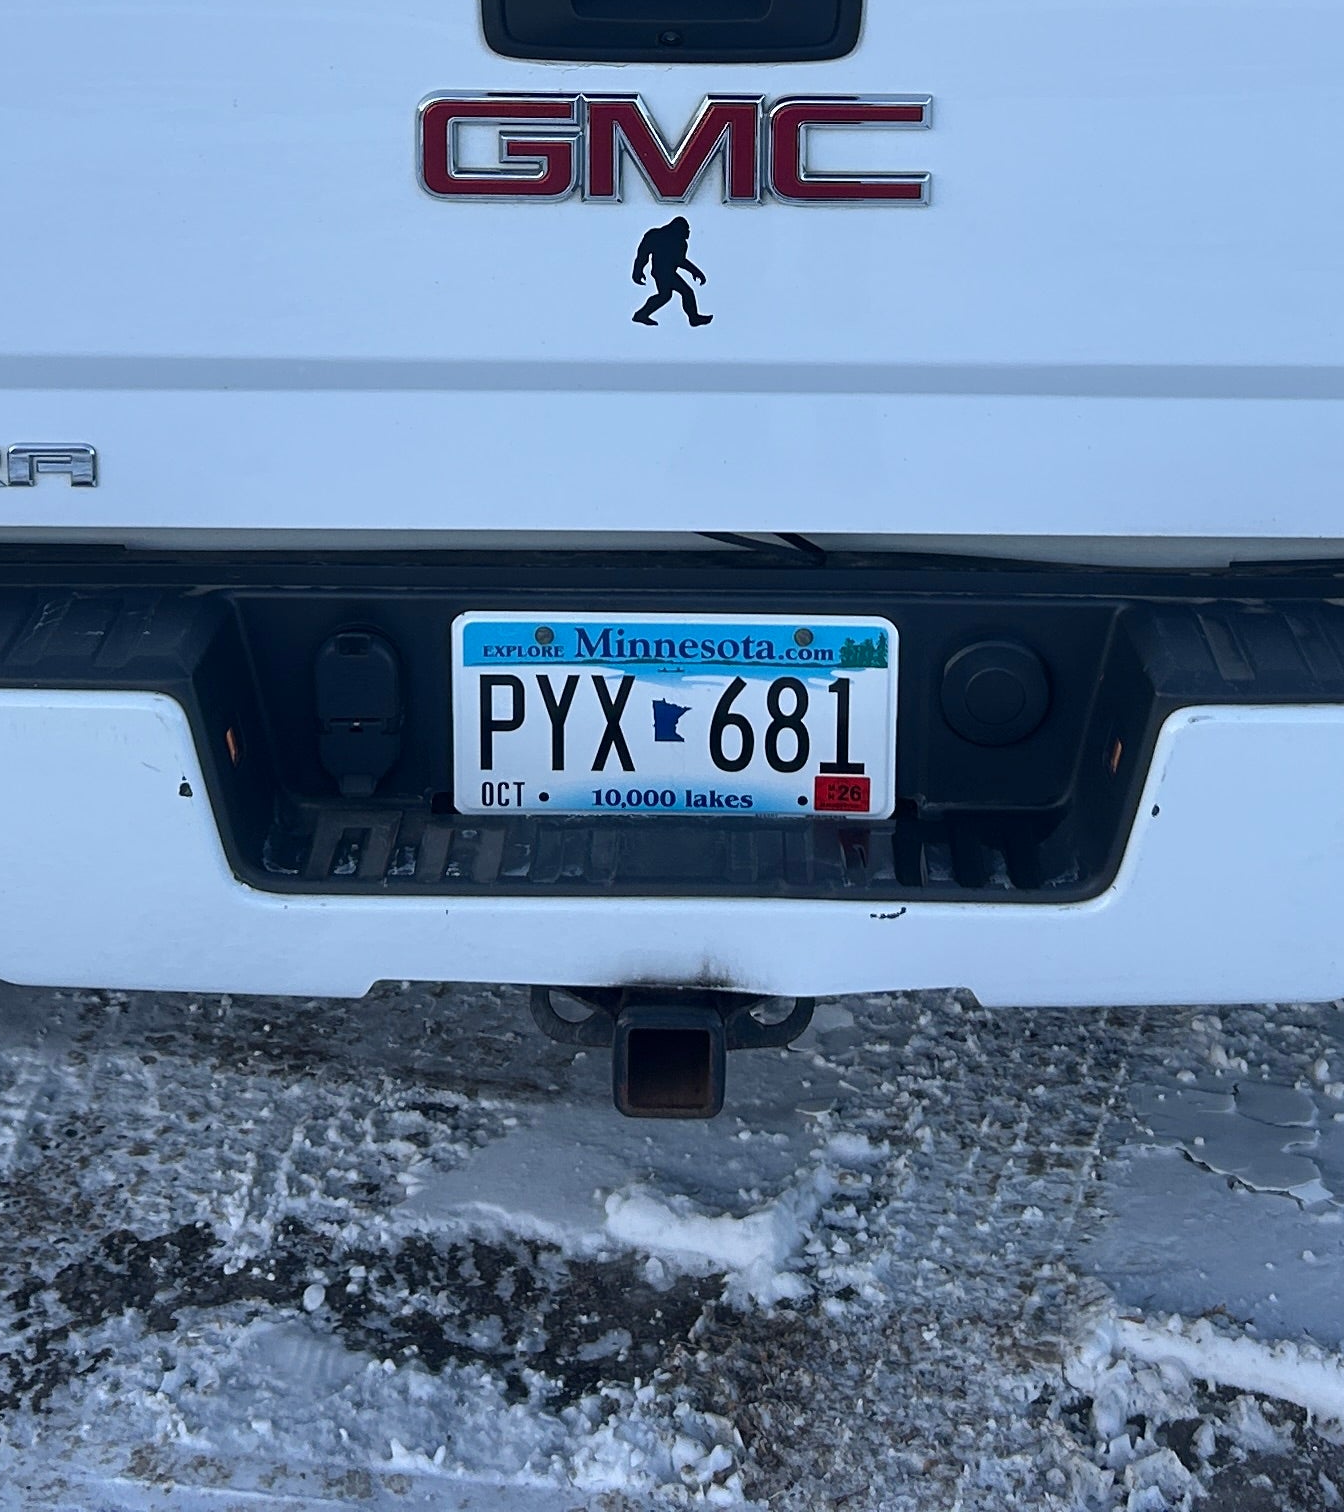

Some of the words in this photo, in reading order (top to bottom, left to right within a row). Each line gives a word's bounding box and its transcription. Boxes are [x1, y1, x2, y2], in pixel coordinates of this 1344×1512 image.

[416, 89, 934, 207] GMC
[483, 644, 565, 658] EXPLORE
[574, 627, 834, 662] Minnesota.com
[479, 674, 636, 772] PYX
[708, 675, 866, 775] 681
[480, 781, 526, 808] OCT
[591, 788, 677, 809] 10,000
[685, 789, 755, 809] lakes
